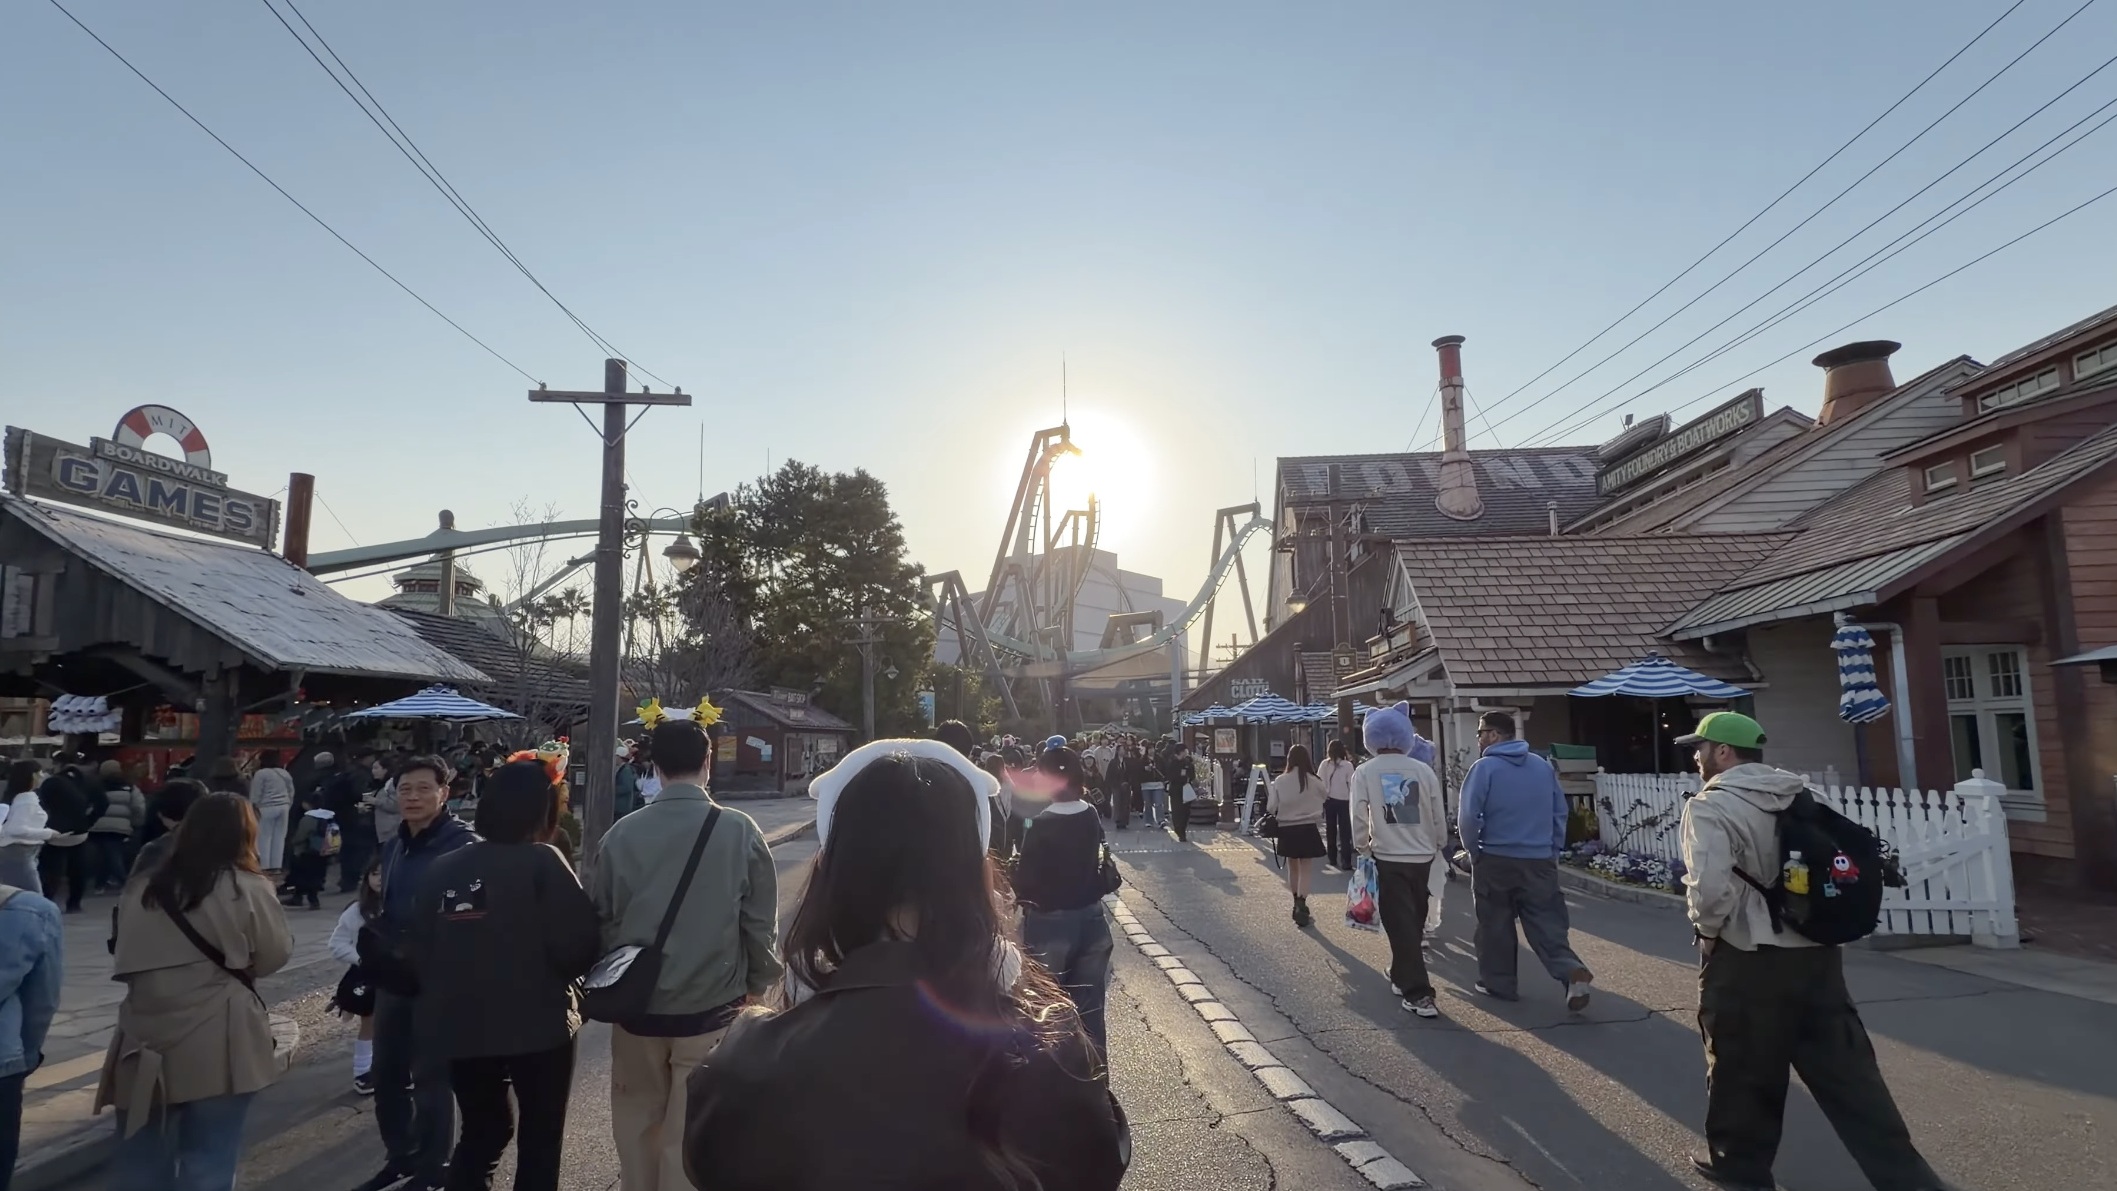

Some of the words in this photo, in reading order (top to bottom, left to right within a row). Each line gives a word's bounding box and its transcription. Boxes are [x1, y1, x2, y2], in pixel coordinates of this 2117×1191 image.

[150, 415, 189, 435] MIT
[1601, 466, 1628, 491] AMITY
[1627, 444, 1670, 479] FOUNDRY
[1669, 442, 1677, 458] &
[1676, 400, 1750, 453] BOATWORKS
[58, 456, 255, 531] GAMES
[104, 442, 224, 486] BOARDWALK
